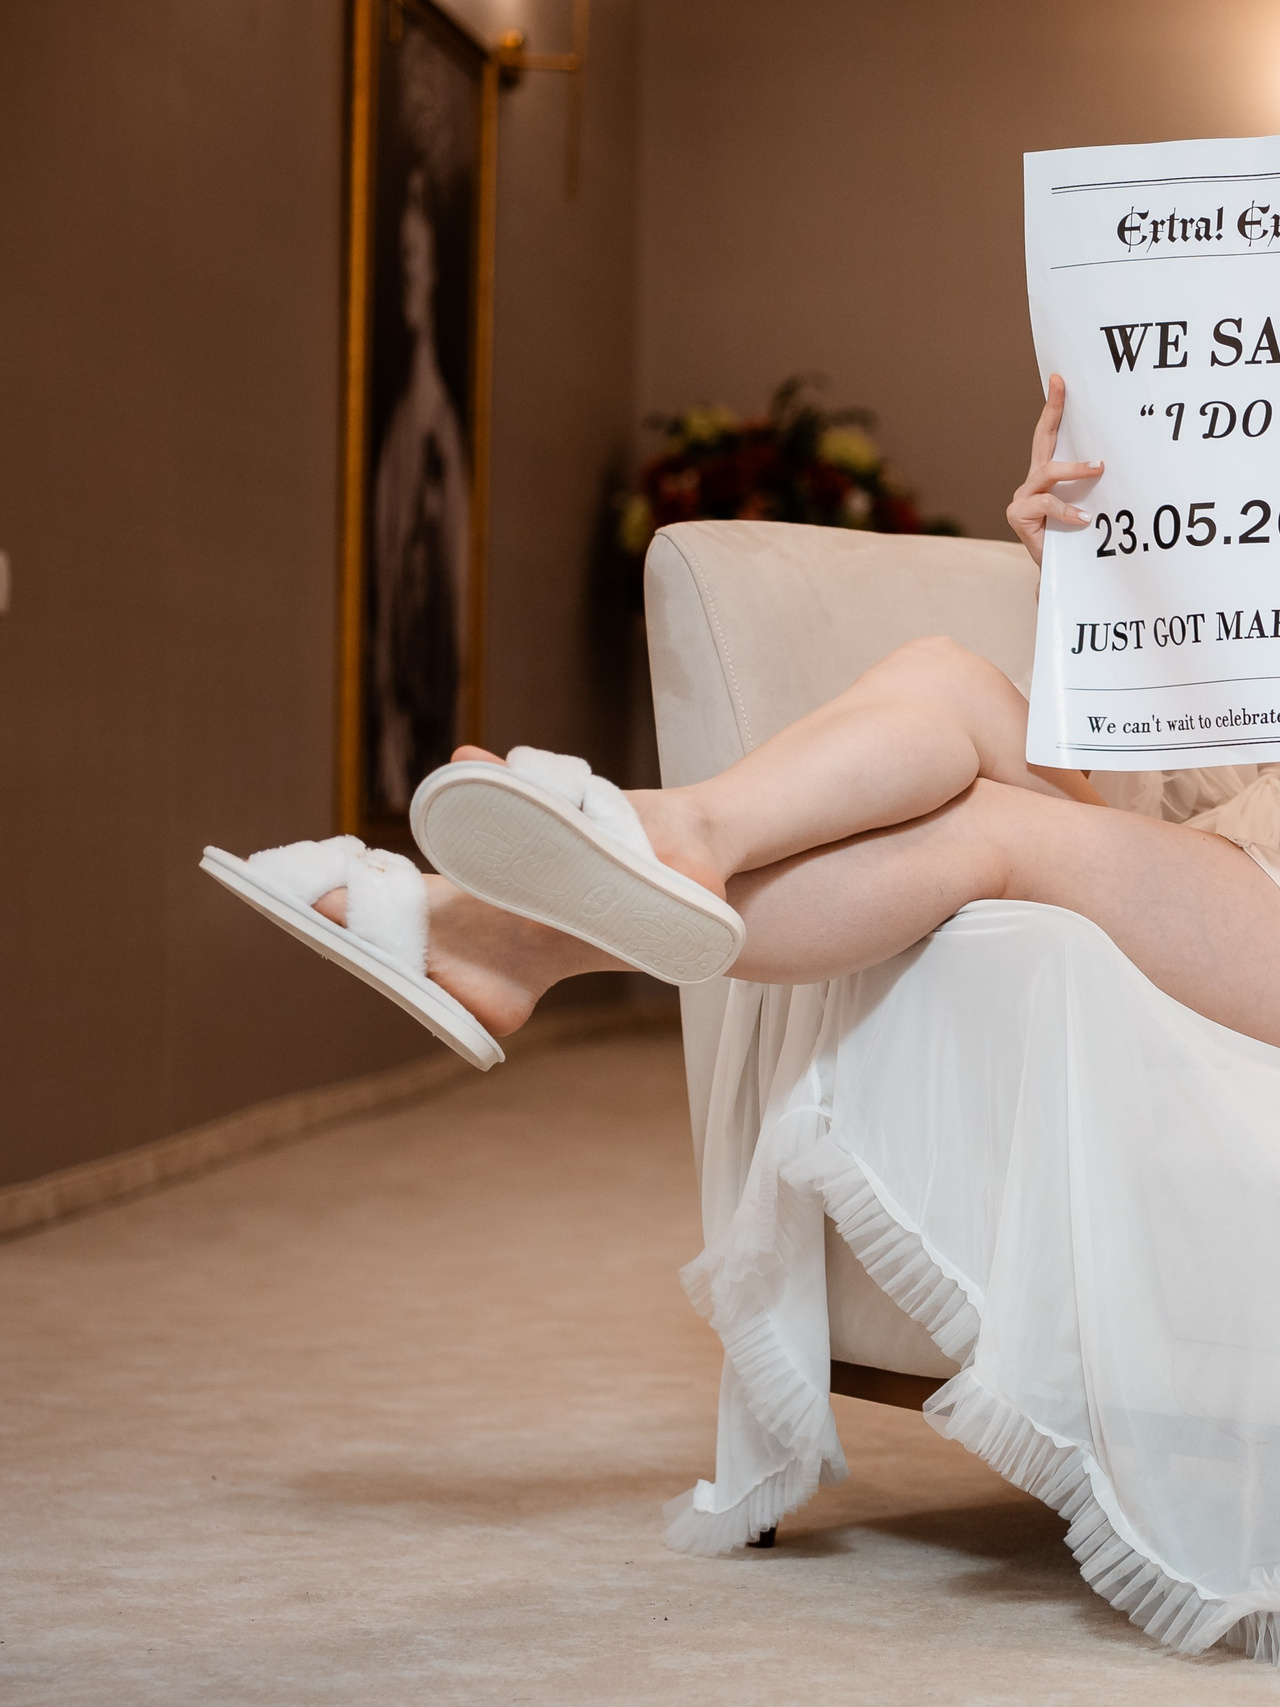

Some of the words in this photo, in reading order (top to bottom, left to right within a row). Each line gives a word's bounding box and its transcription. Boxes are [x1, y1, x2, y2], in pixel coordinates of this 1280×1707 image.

[1117, 206, 1224, 253] Extra!
[1099, 320, 1188, 373] WE
[1070, 619, 1146, 655] JUST
[1153, 613, 1206, 648] GOT
[1087, 716, 1116, 734] We
[1122, 715, 1162, 734] can't
[1166, 713, 1196, 731] wait
[1198, 714, 1212, 730] to
